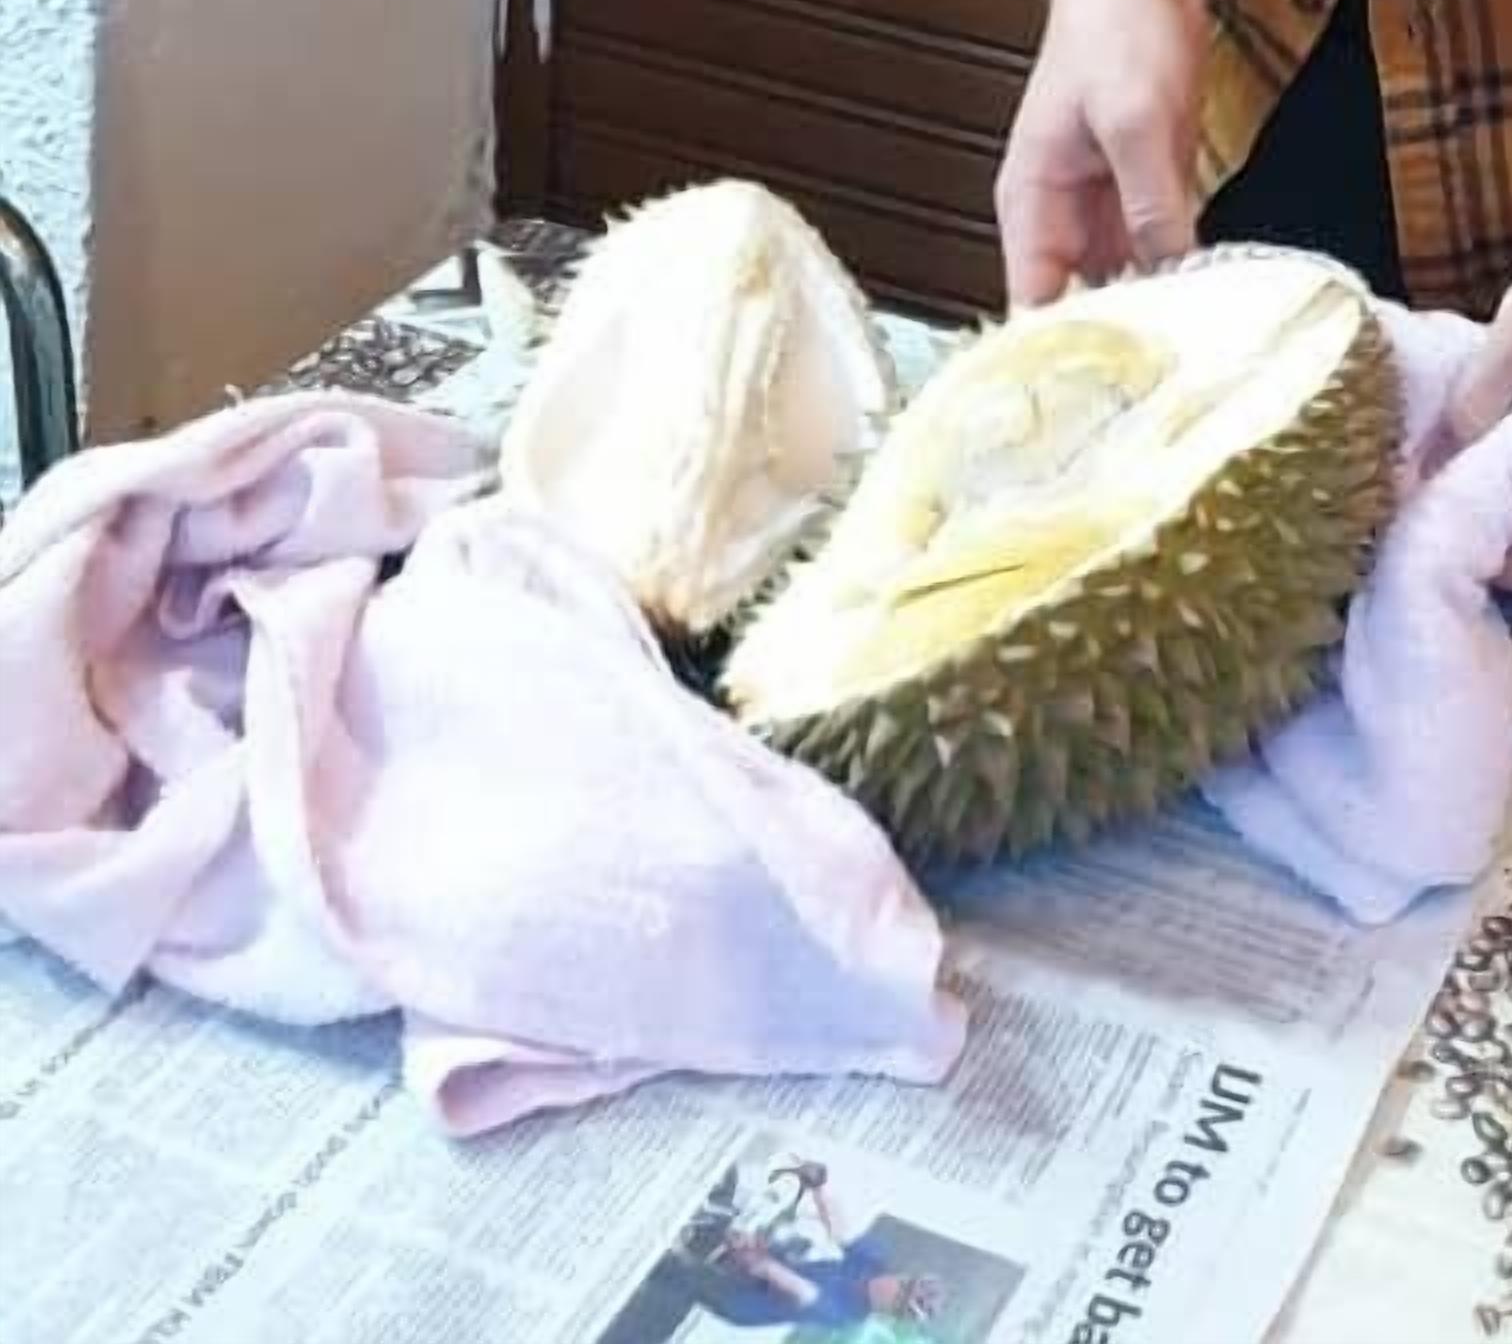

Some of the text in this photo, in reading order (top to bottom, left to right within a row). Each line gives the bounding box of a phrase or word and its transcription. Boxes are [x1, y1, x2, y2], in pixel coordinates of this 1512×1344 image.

[1183, 1062, 1264, 1154] UM
[1153, 1159, 1211, 1208] to
[1105, 1211, 1171, 1289] get
